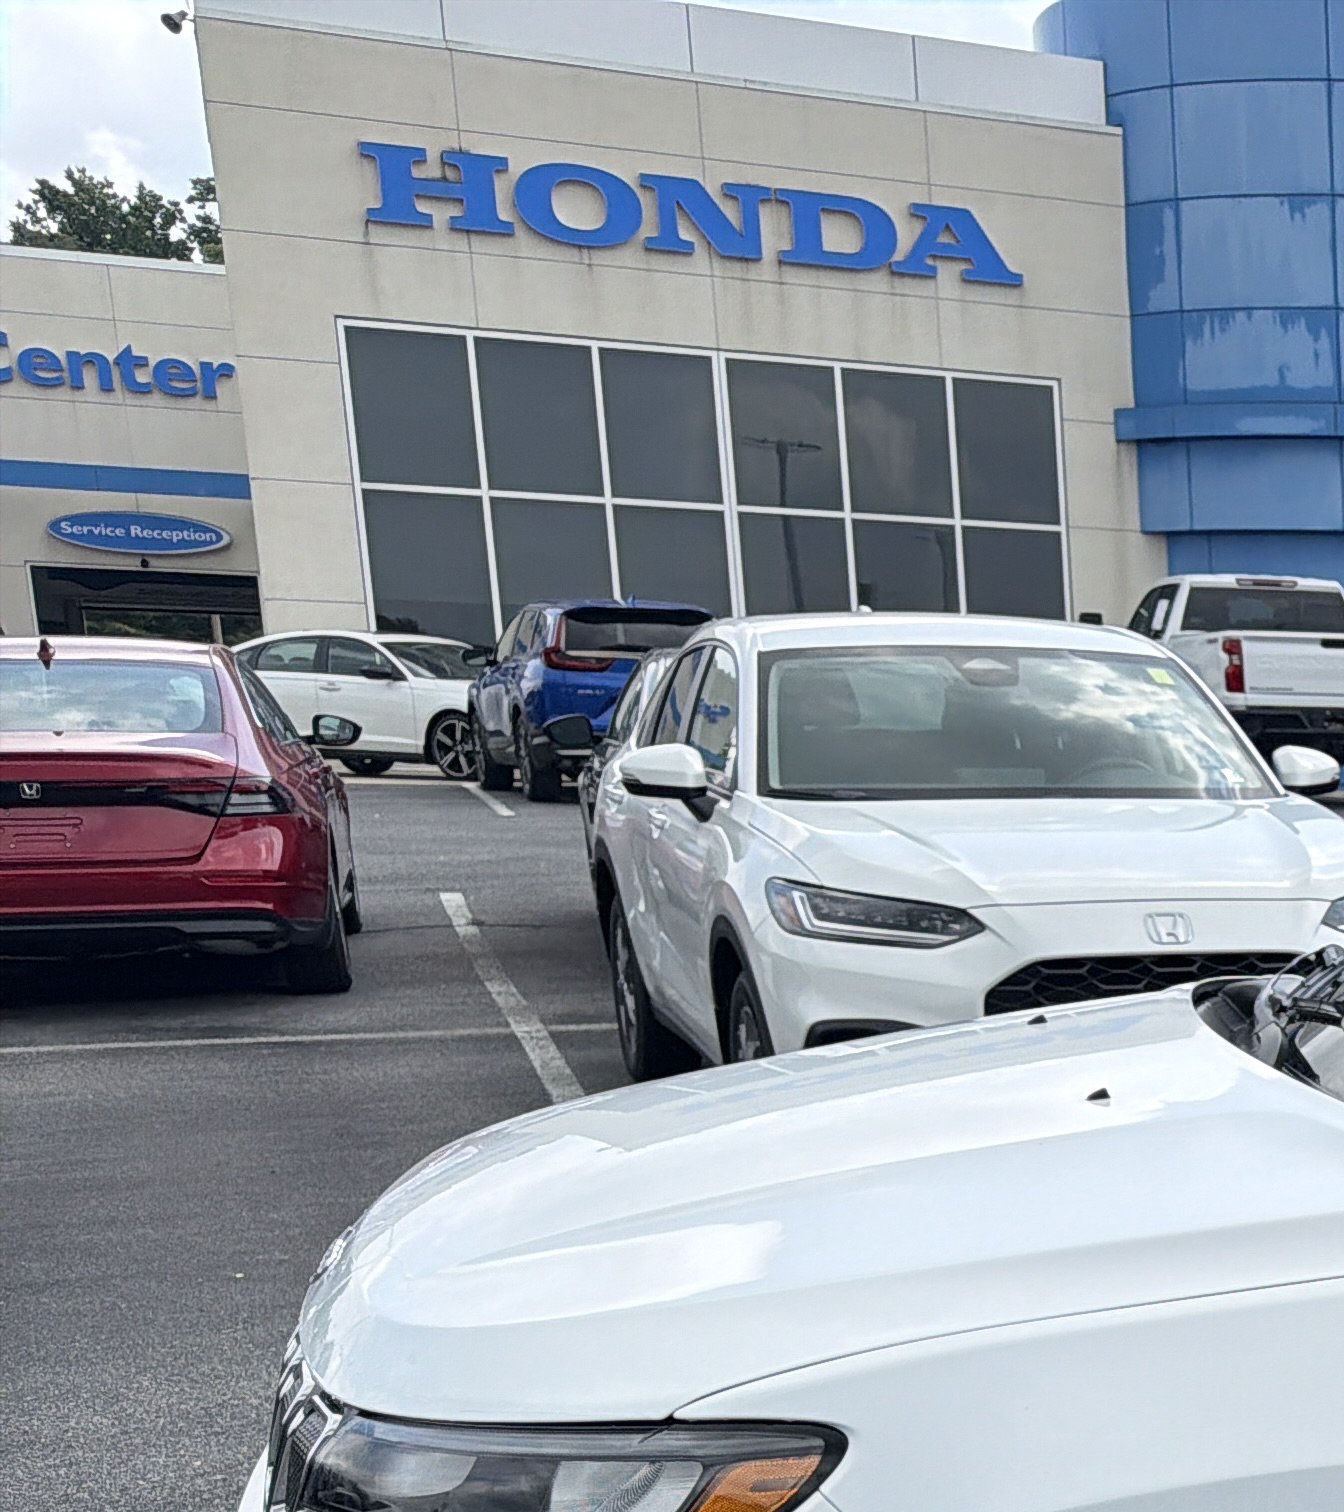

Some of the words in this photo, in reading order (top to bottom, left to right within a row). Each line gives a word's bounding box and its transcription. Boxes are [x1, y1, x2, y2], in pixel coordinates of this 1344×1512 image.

[358, 141, 1024, 287] HONDA
[0, 331, 236, 400] enter
[59, 521, 126, 537] Service
[130, 525, 217, 543] Reception
